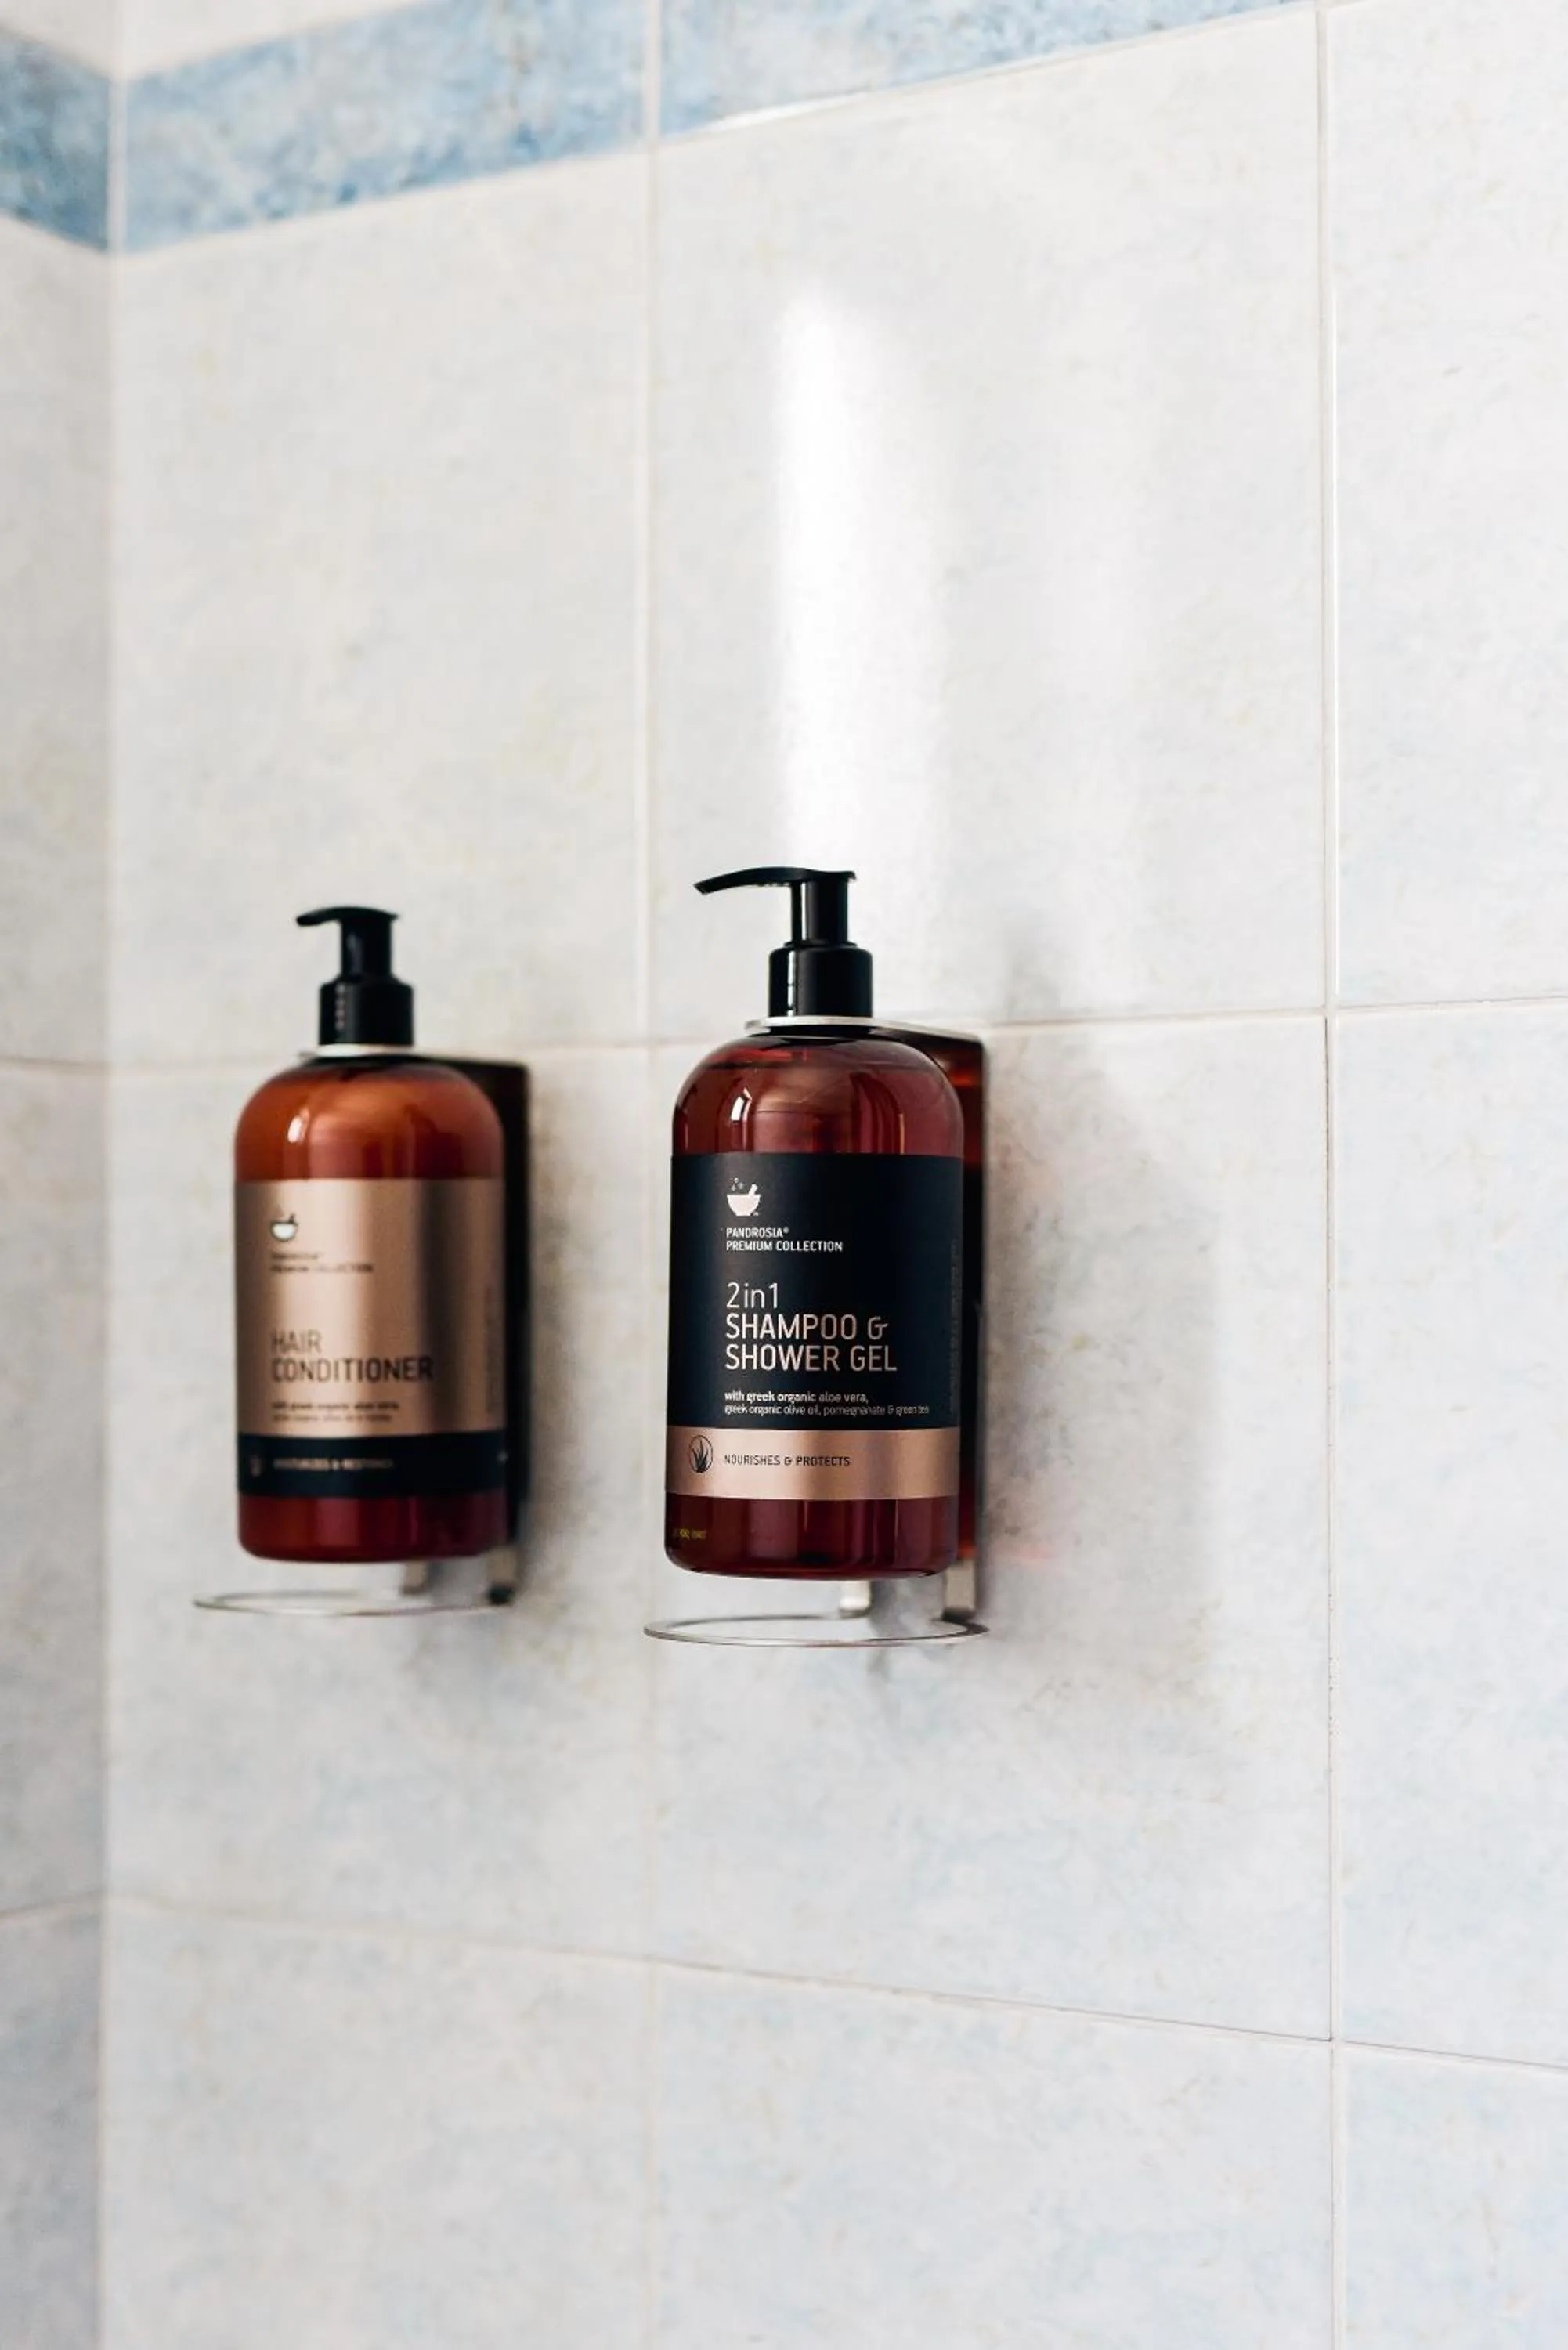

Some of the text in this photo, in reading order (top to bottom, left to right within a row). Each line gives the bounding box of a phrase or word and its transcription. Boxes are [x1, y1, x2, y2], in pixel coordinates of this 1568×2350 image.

[726, 1240, 843, 1252] PREMIUM COLLECTION
[725, 1313, 888, 1340] SHAMPOO &
[271, 1330, 322, 1354] HAIR
[725, 1343, 897, 1372] SHOWER GEL
[272, 1357, 434, 1383] CONDITIONER
[724, 1390, 869, 1404] with greek organic aloe vera,
[749, 1405, 782, 1416] organic
[784, 1405, 805, 1415] olive
[724, 1454, 781, 1466] NOURISHES
[796, 1456, 851, 1466] PROTECTS
